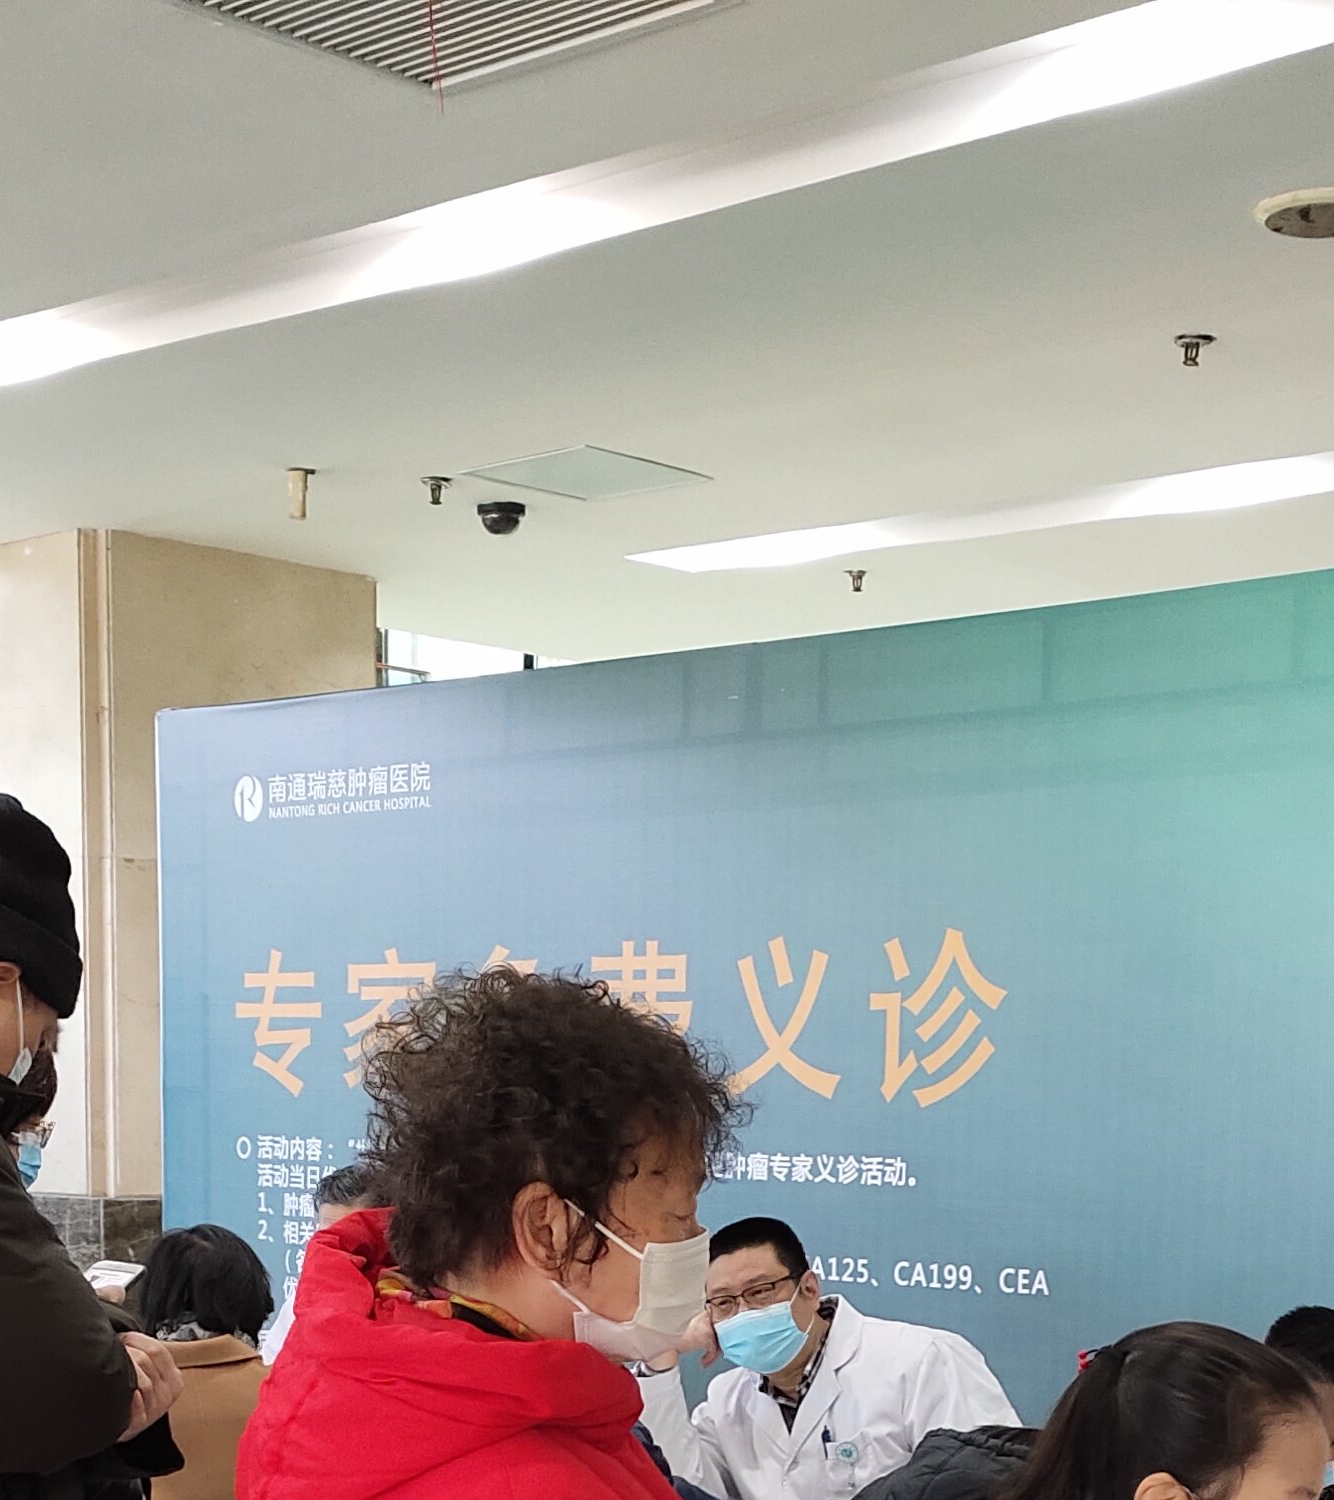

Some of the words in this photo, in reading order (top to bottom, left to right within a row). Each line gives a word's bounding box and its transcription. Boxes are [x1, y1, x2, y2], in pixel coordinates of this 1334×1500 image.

[268, 761, 431, 804] 南通瑞慈肿瘤医院
[268, 803, 315, 819] NANTONG
[318, 801, 340, 816] RICH
[343, 799, 380, 814] CANCER
[383, 795, 432, 811] HOSPITAL
[258, 1219, 320, 1246] 2、相关
